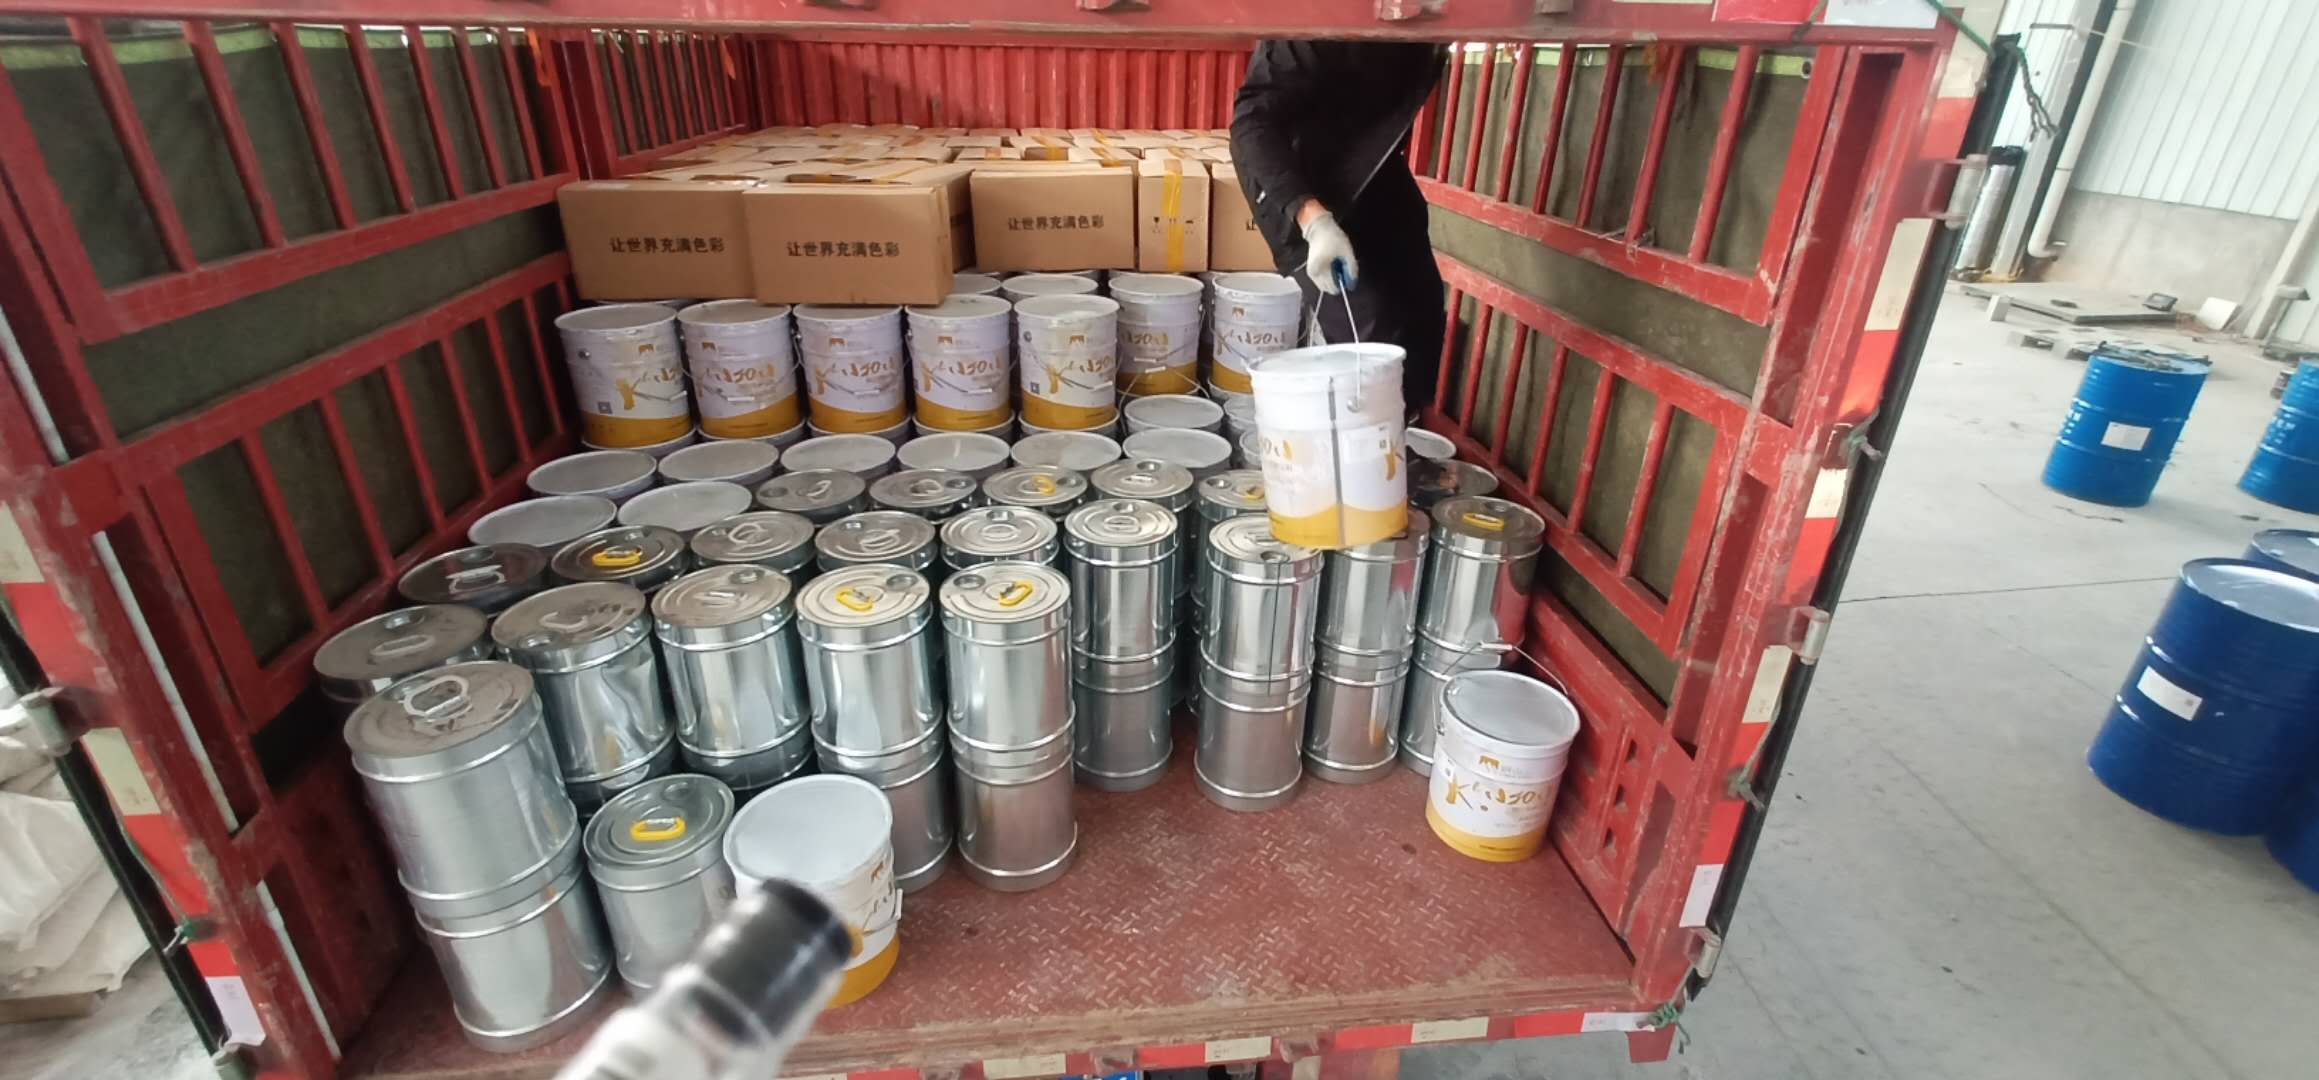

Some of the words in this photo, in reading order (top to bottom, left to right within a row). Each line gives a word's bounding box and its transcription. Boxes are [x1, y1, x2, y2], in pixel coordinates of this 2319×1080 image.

[1007, 214, 1105, 231] 让世界充满色彩
[609, 236, 725, 254] 让世界充满色彩
[786, 240, 900, 258] 让世界充满色彩
